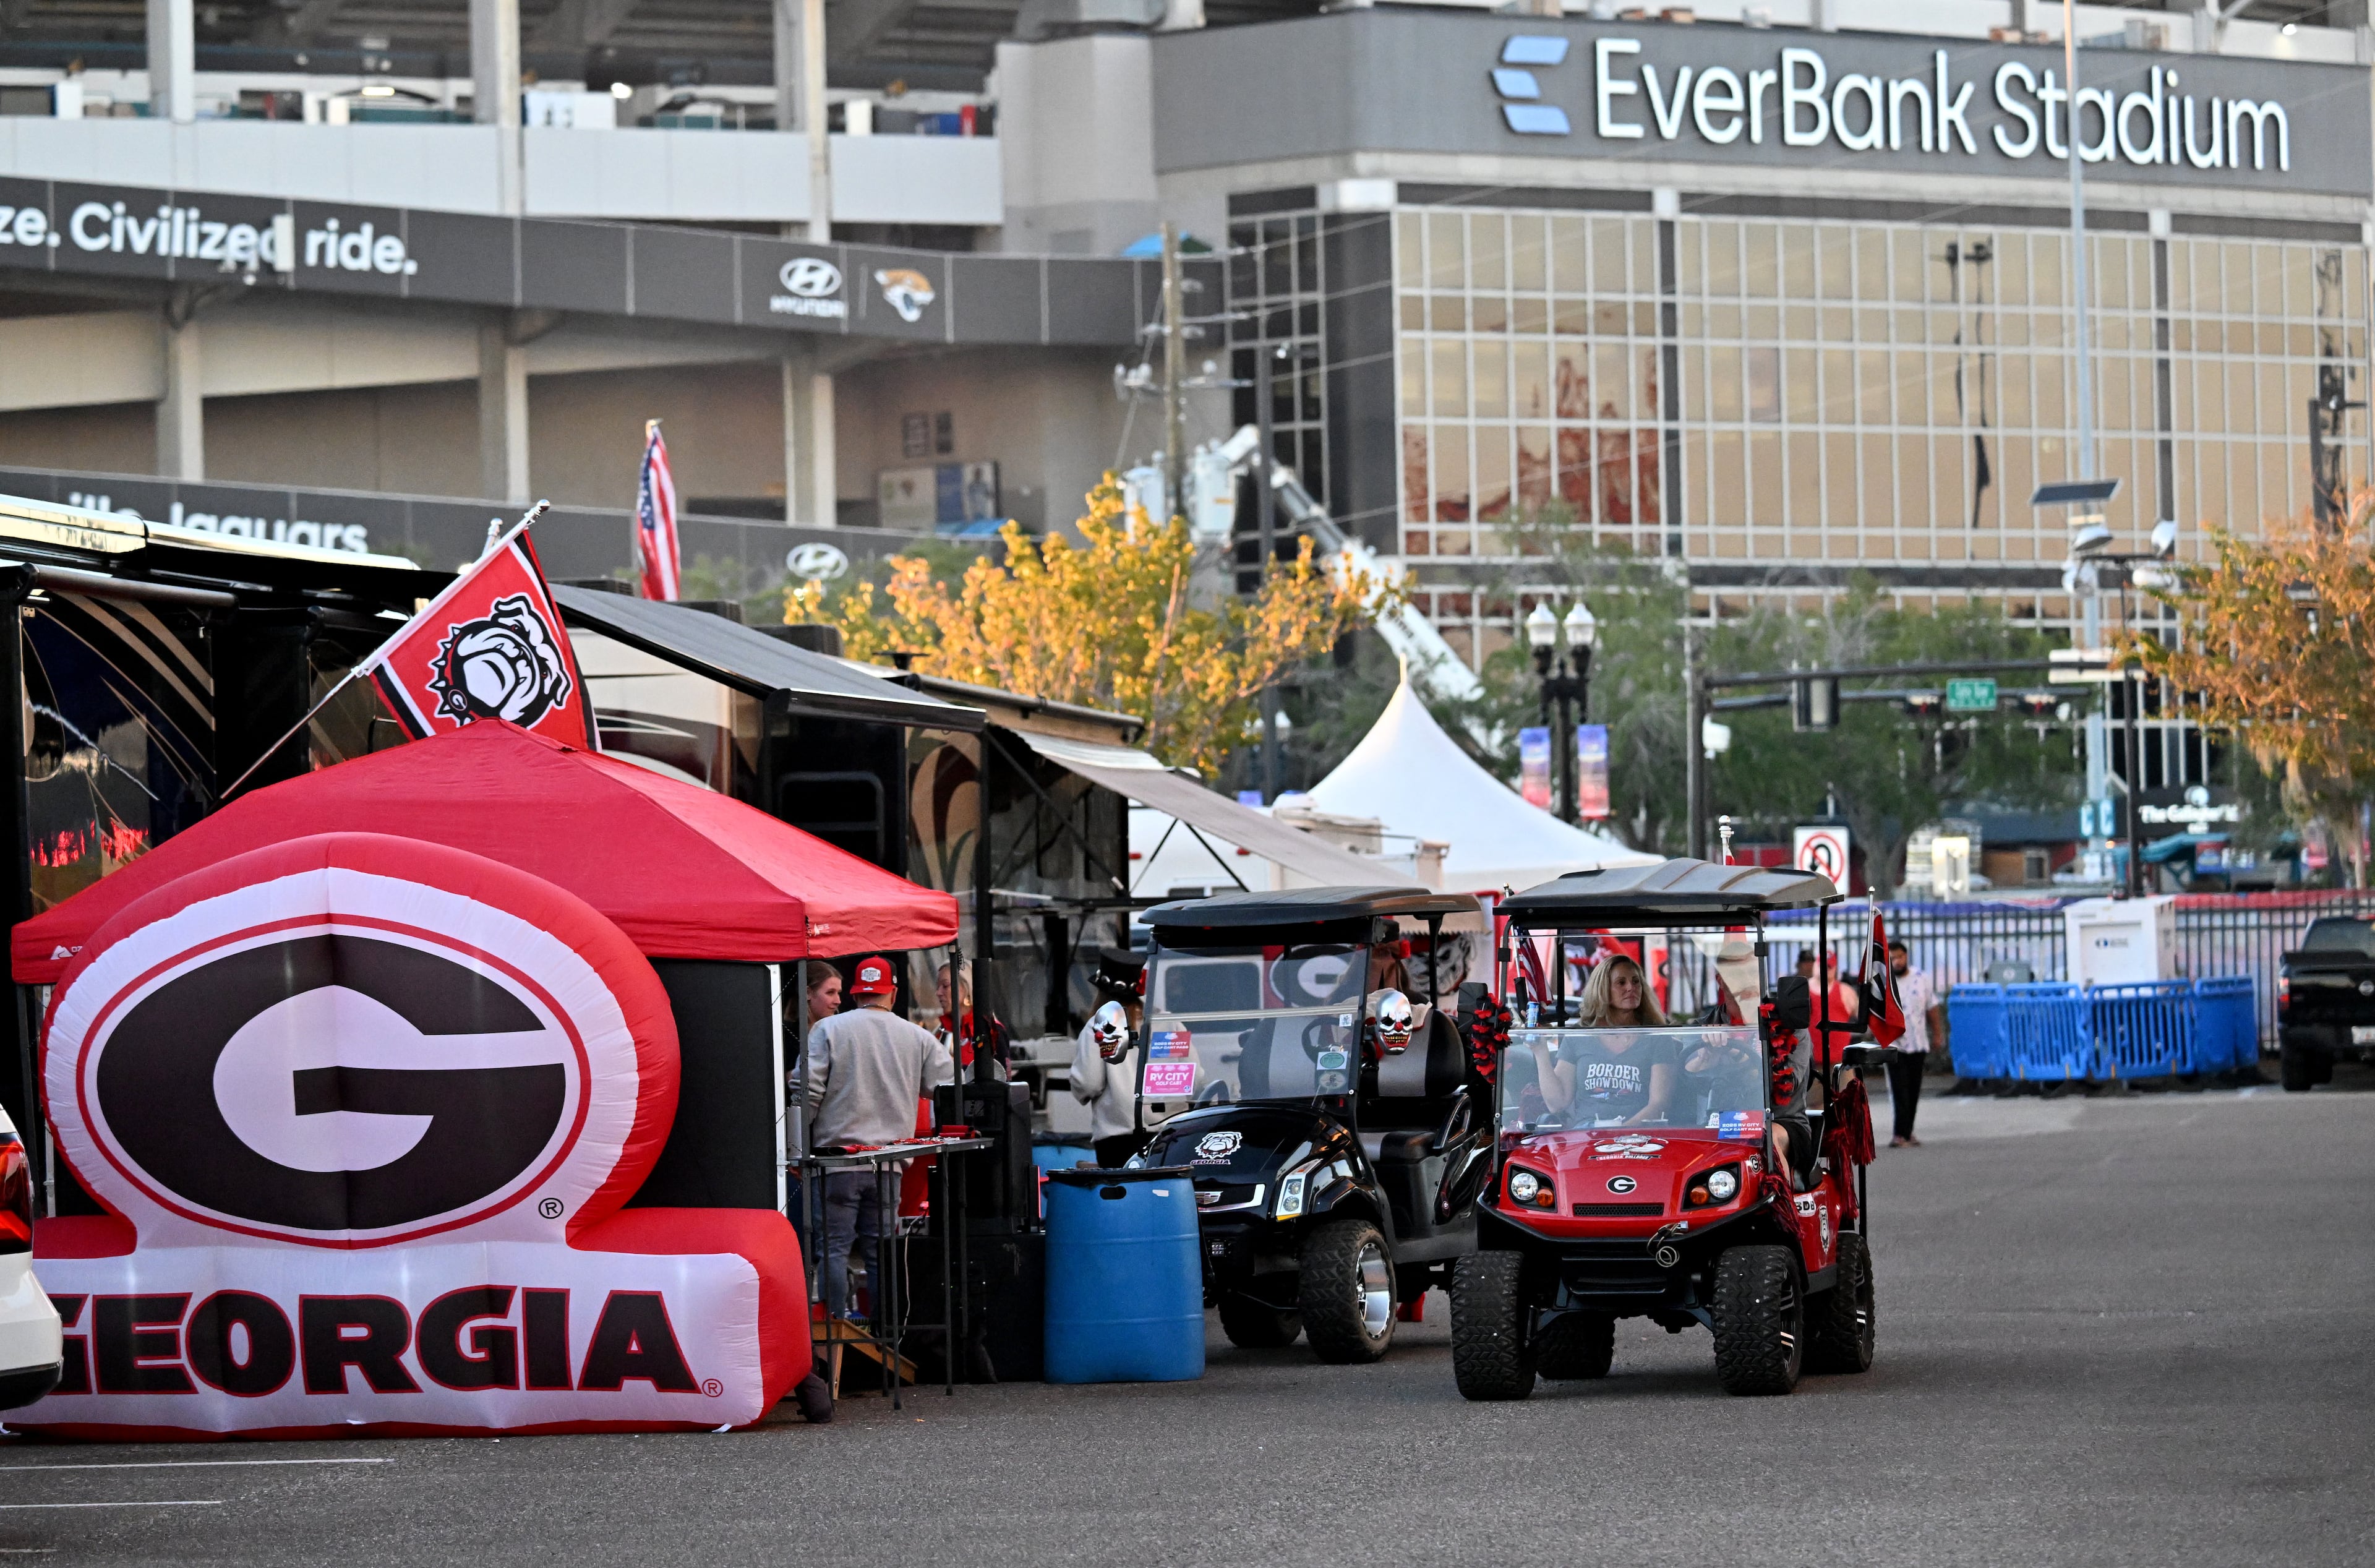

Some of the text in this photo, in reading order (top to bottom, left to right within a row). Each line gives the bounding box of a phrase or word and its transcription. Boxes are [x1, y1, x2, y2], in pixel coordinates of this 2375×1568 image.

[1596, 37, 2290, 172] EverBank Stadium
[305, 217, 418, 275] ride.
[97, 933, 566, 1230] G
[1150, 1072, 1189, 1081] RV CITY
[1586, 1063, 1640, 1082] BORDER
[1585, 1077, 1642, 1093] SHOWDOWN
[1607, 1176, 1636, 1193] G
